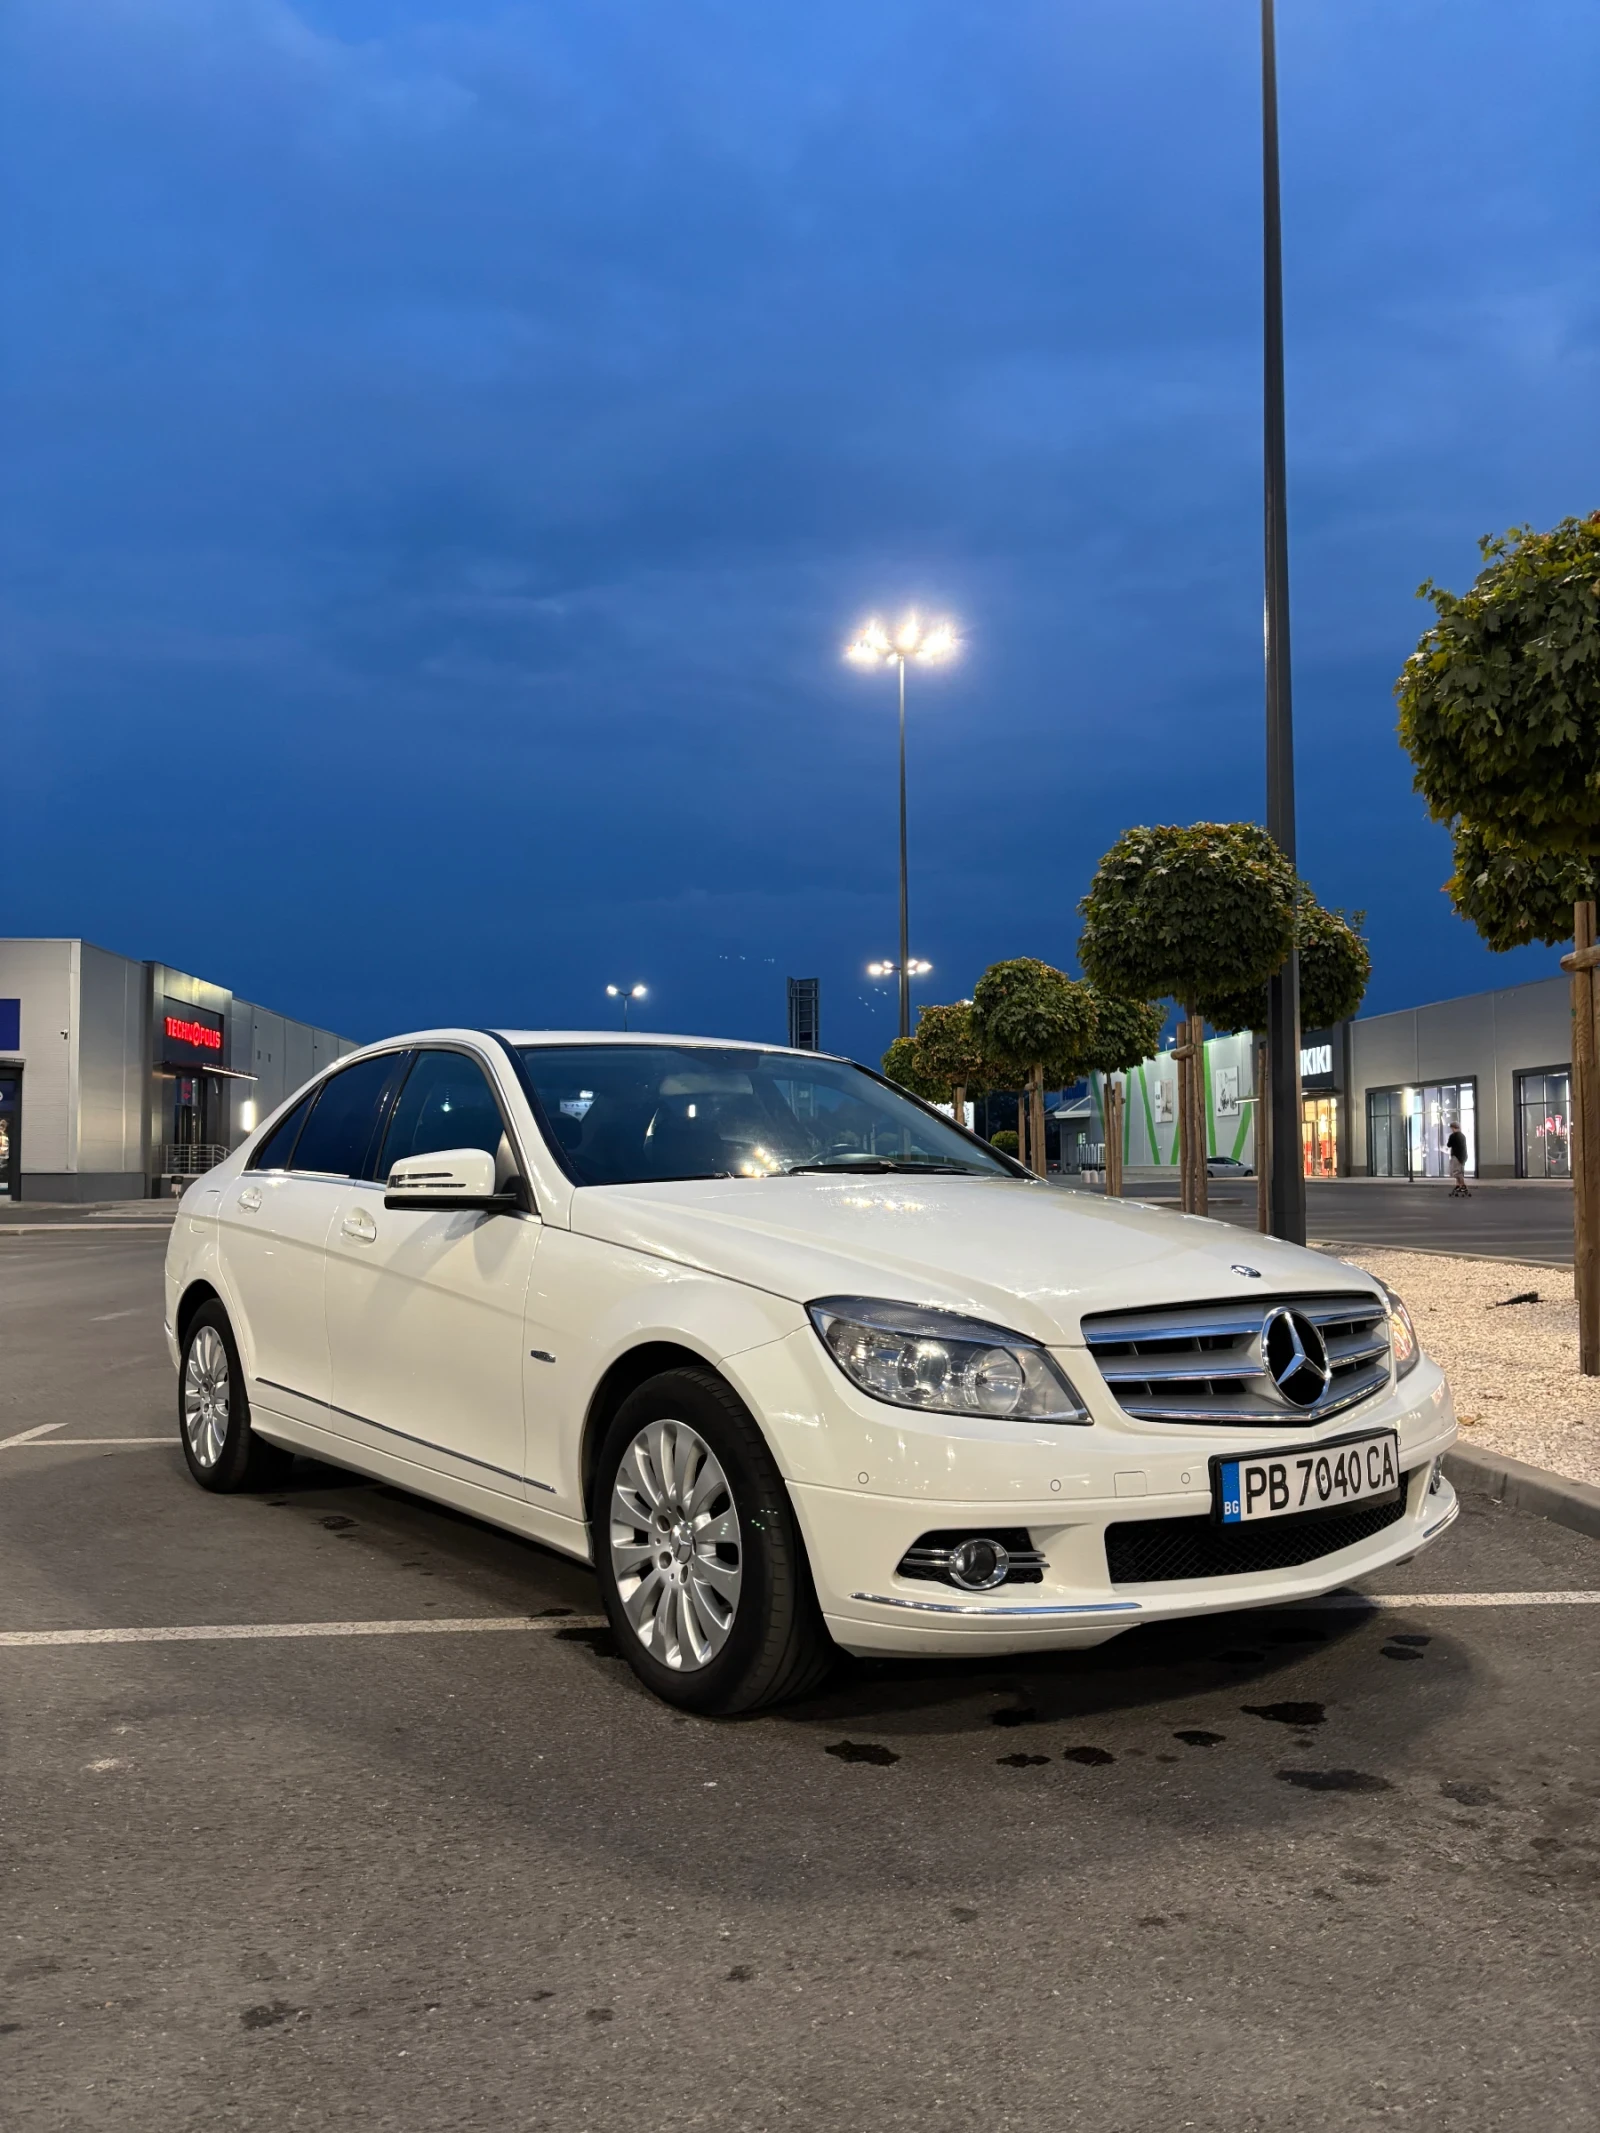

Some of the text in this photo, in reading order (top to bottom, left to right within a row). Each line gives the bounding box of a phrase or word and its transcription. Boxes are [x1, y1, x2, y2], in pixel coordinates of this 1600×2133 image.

[166, 1016, 220, 1048] TECHNOPOLIS
[1300, 1045, 1332, 1076] IKIKI
[1245, 1442, 1395, 1514] PB 7040 CA
[1224, 1500, 1239, 1515] BG
